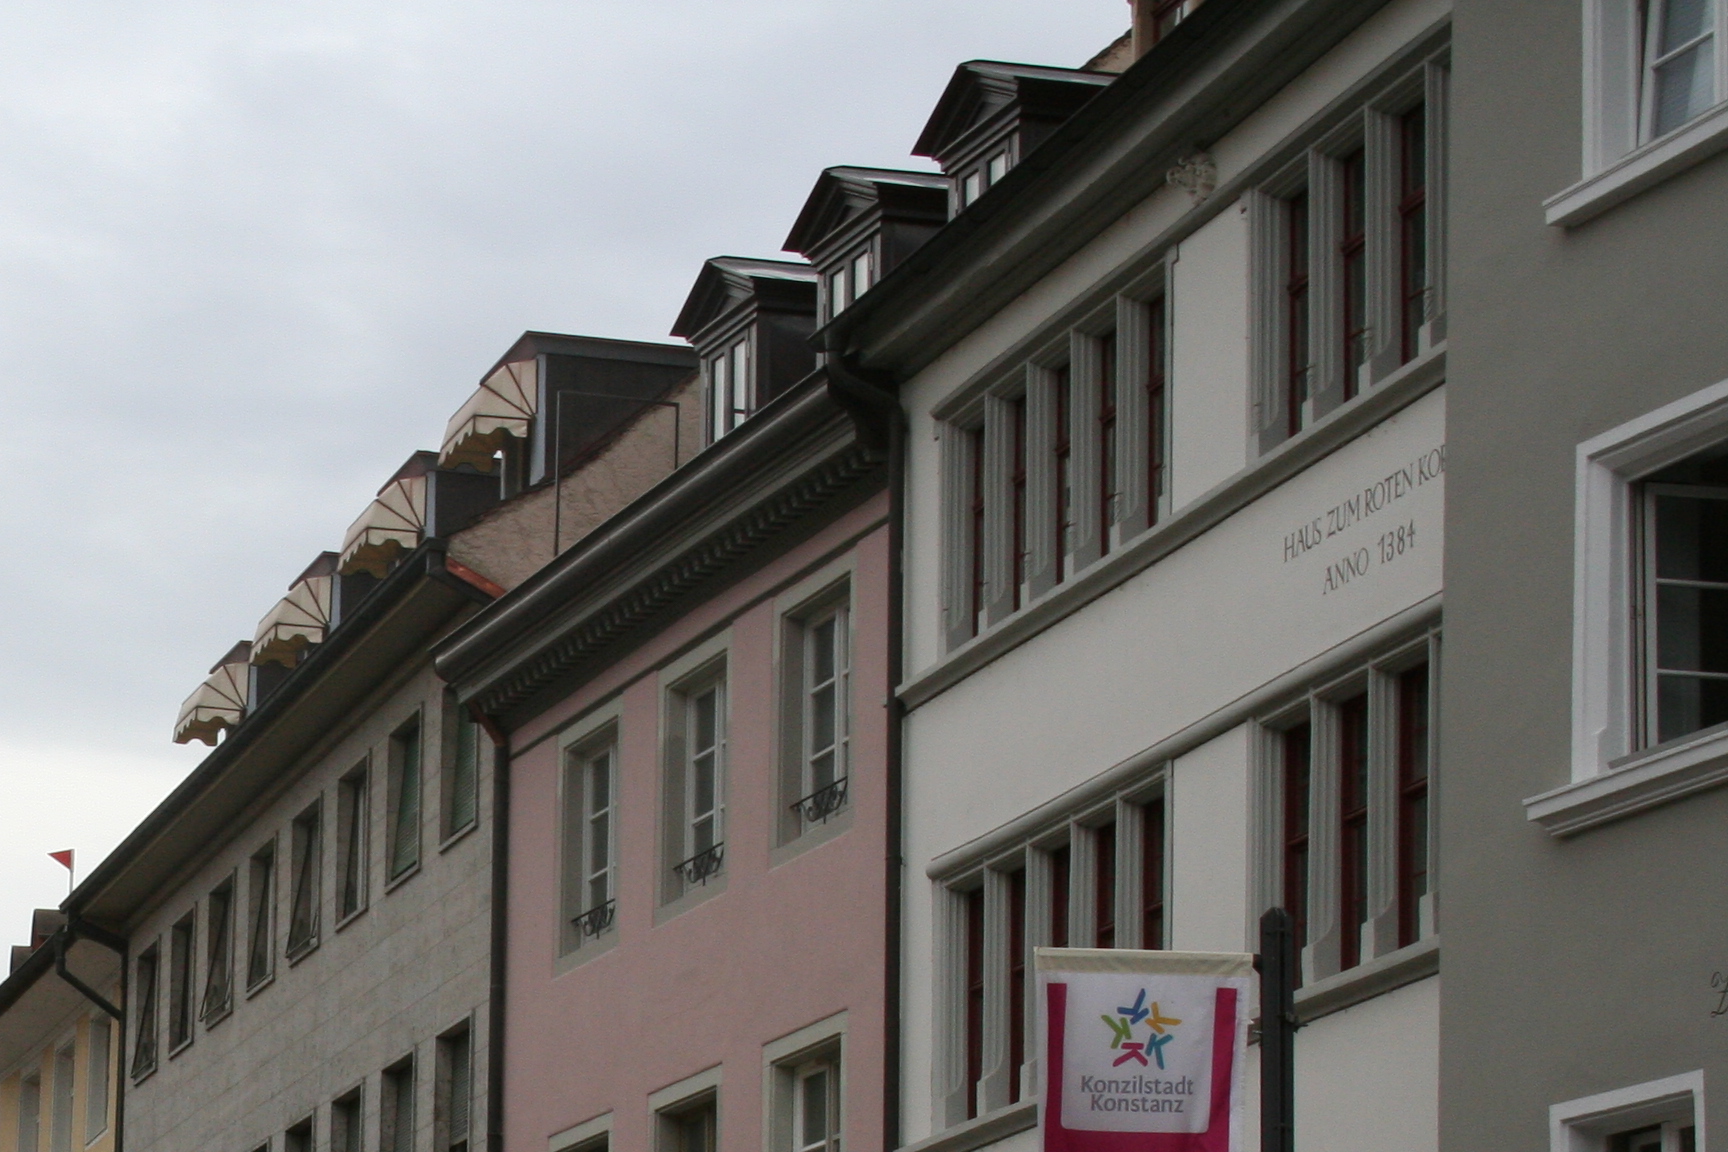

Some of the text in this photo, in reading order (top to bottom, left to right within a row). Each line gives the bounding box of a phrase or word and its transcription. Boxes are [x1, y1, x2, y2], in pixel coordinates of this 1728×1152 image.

[1283, 517, 1322, 563] HAUS
[1326, 494, 1361, 539] ZUM
[1364, 463, 1415, 518] ROTEN
[1322, 519, 1416, 595] ANNO 1384
[1080, 1075, 1194, 1095] Konzilstadt
[1090, 1094, 1184, 1113] Konstanz
